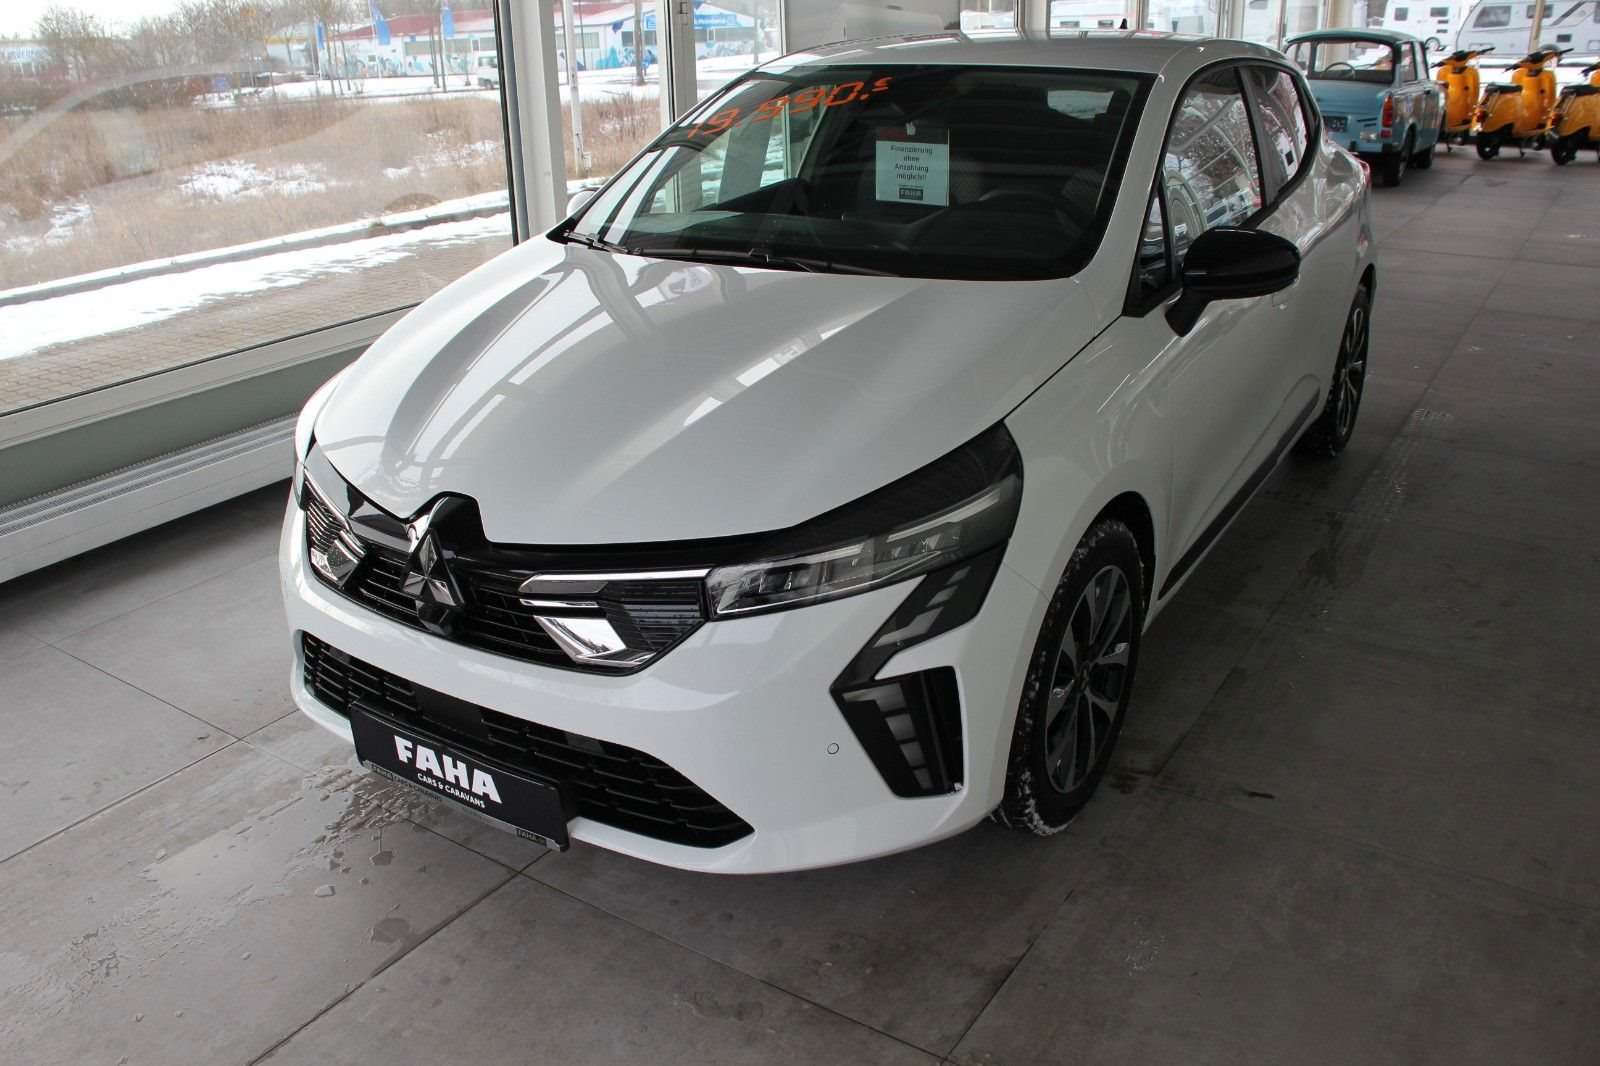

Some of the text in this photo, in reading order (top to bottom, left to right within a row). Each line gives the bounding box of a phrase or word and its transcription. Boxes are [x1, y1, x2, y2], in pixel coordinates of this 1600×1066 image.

[895, 163, 929, 173] Anzahlung
[394, 735, 502, 804] FAHA
[417, 773, 486, 808] CARS & CARAVANS
